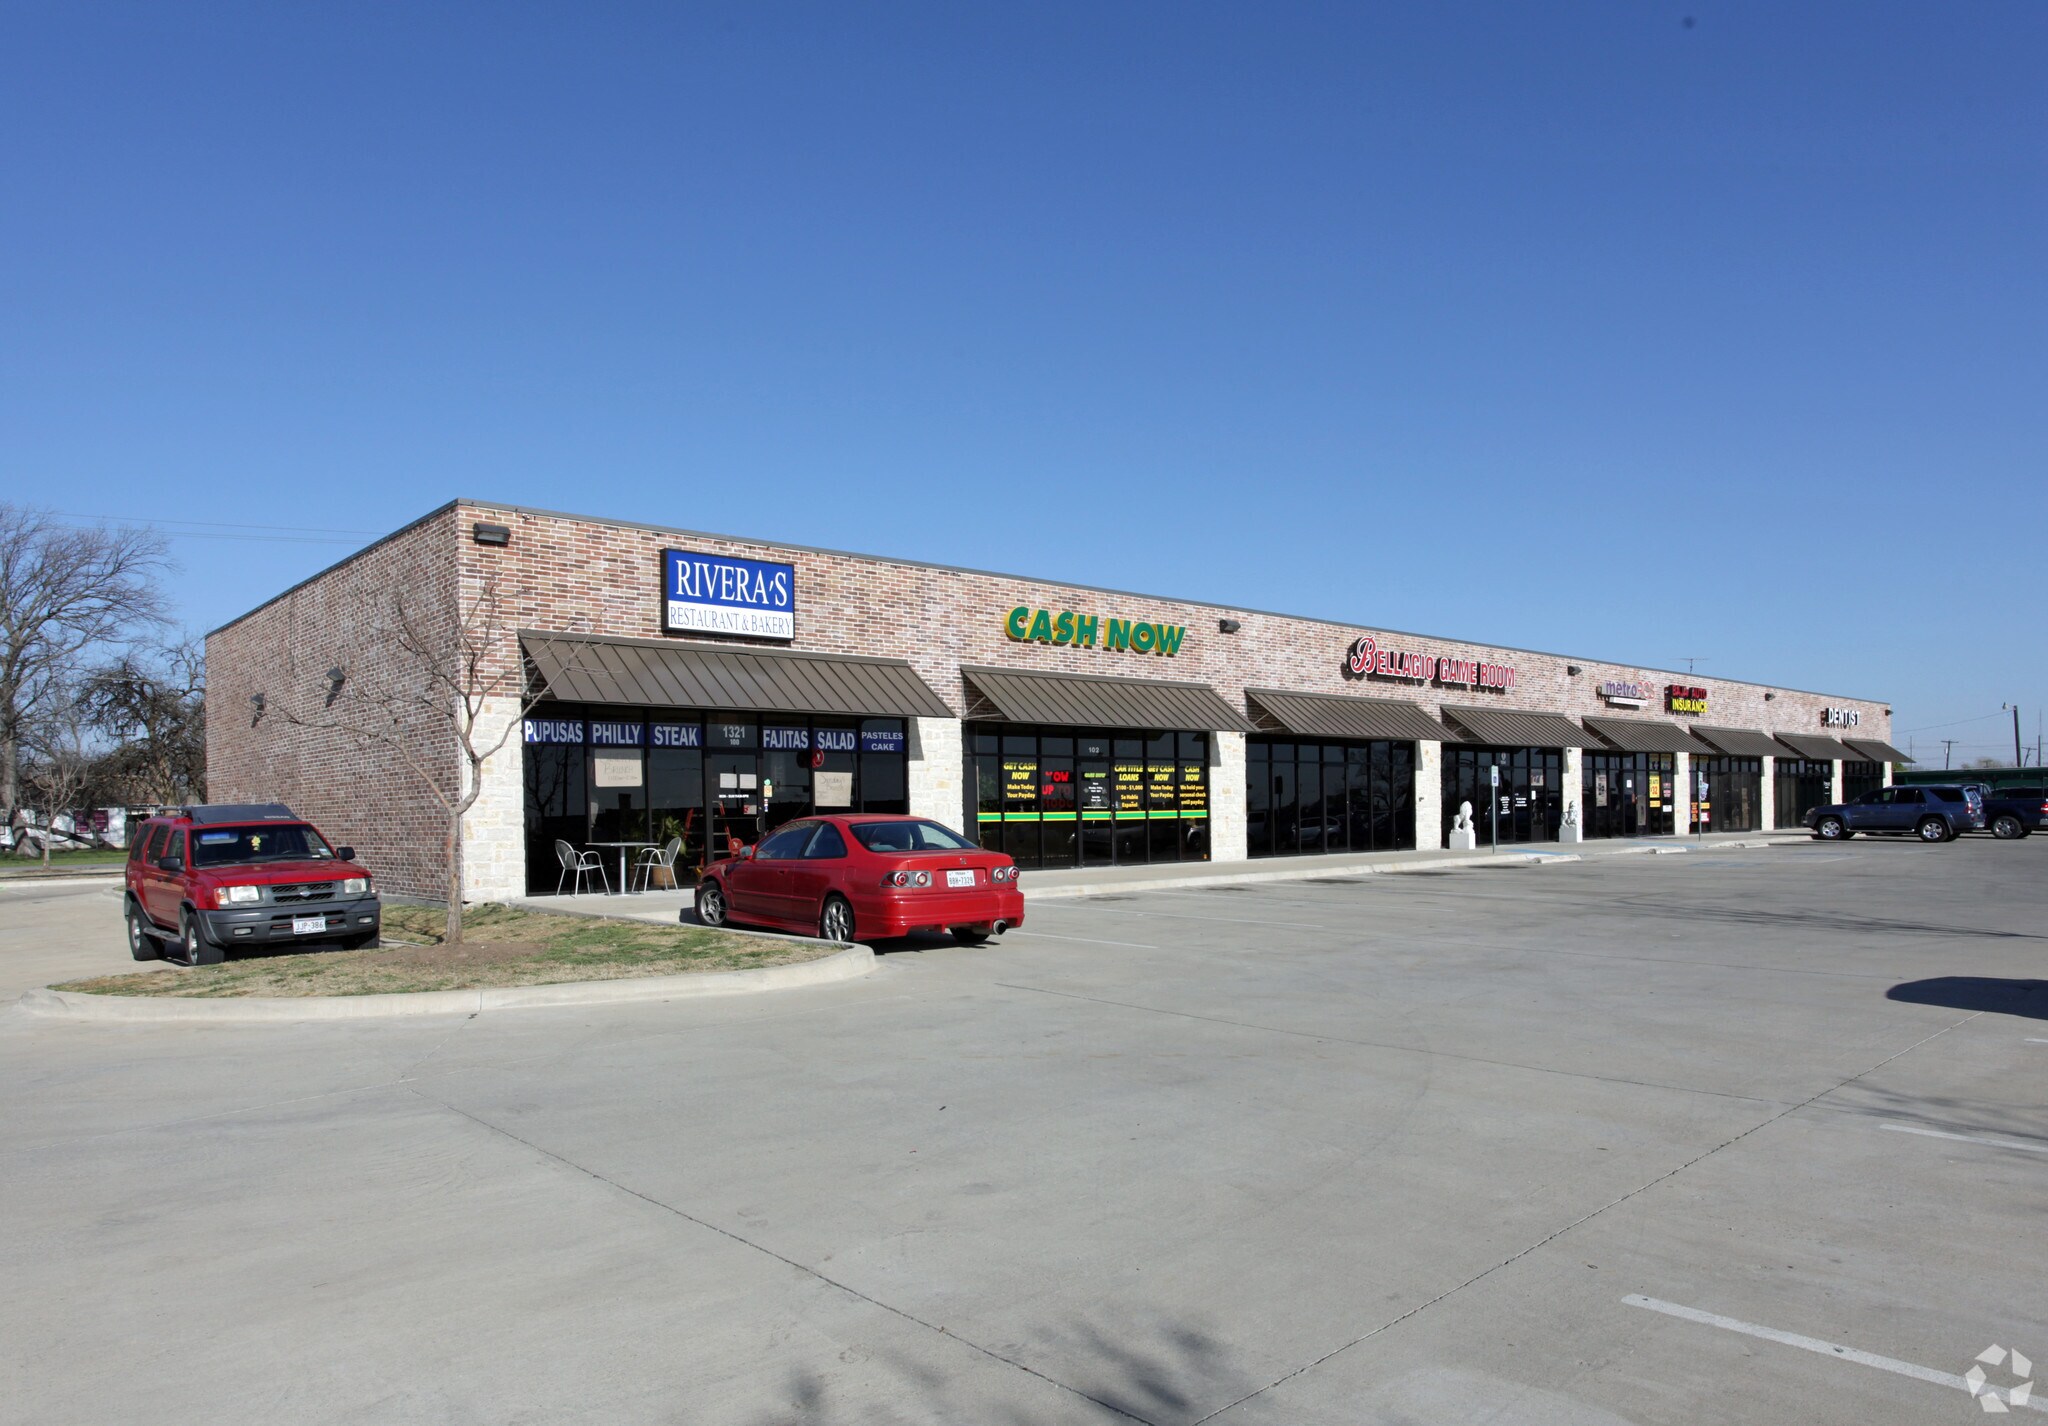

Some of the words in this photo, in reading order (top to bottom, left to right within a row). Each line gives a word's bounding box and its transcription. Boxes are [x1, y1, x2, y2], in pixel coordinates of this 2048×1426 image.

[676, 559, 788, 607] RIVERA'S
[670, 606, 740, 631] RESTAURANT
[742, 614, 750, 632] &
[751, 614, 792, 635] BAKERY
[1004, 606, 1099, 646] CASH
[1104, 617, 1186, 654] NOW
[1351, 636, 1435, 681] BELLAGIO
[1440, 657, 1477, 685] GAME
[1480, 663, 1515, 688] ROOM
[1691, 687, 1708, 699] AUTO
[1672, 698, 1708, 713] INSURANCE
[1828, 707, 1860, 726] DENTIST
[524, 720, 583, 744] PUPUSAS
[592, 723, 641, 745] PHILLY
[654, 725, 698, 747] STEAK
[722, 725, 746, 738] 1321
[763, 729, 809, 749] FAJITAS
[861, 731, 904, 740] PASTELES
[817, 731, 856, 750] SALAD
[871, 743, 895, 751] CAKE
[1003, 762, 1018, 770] GET
[1018, 762, 1037, 771] CASH
[1114, 764, 1128, 772] CAR
[1128, 765, 1143, 773] TITLE
[1011, 771, 1030, 780] NOW
[1119, 773, 1139, 781] LOANS
[1041, 784, 1055, 795] UP
